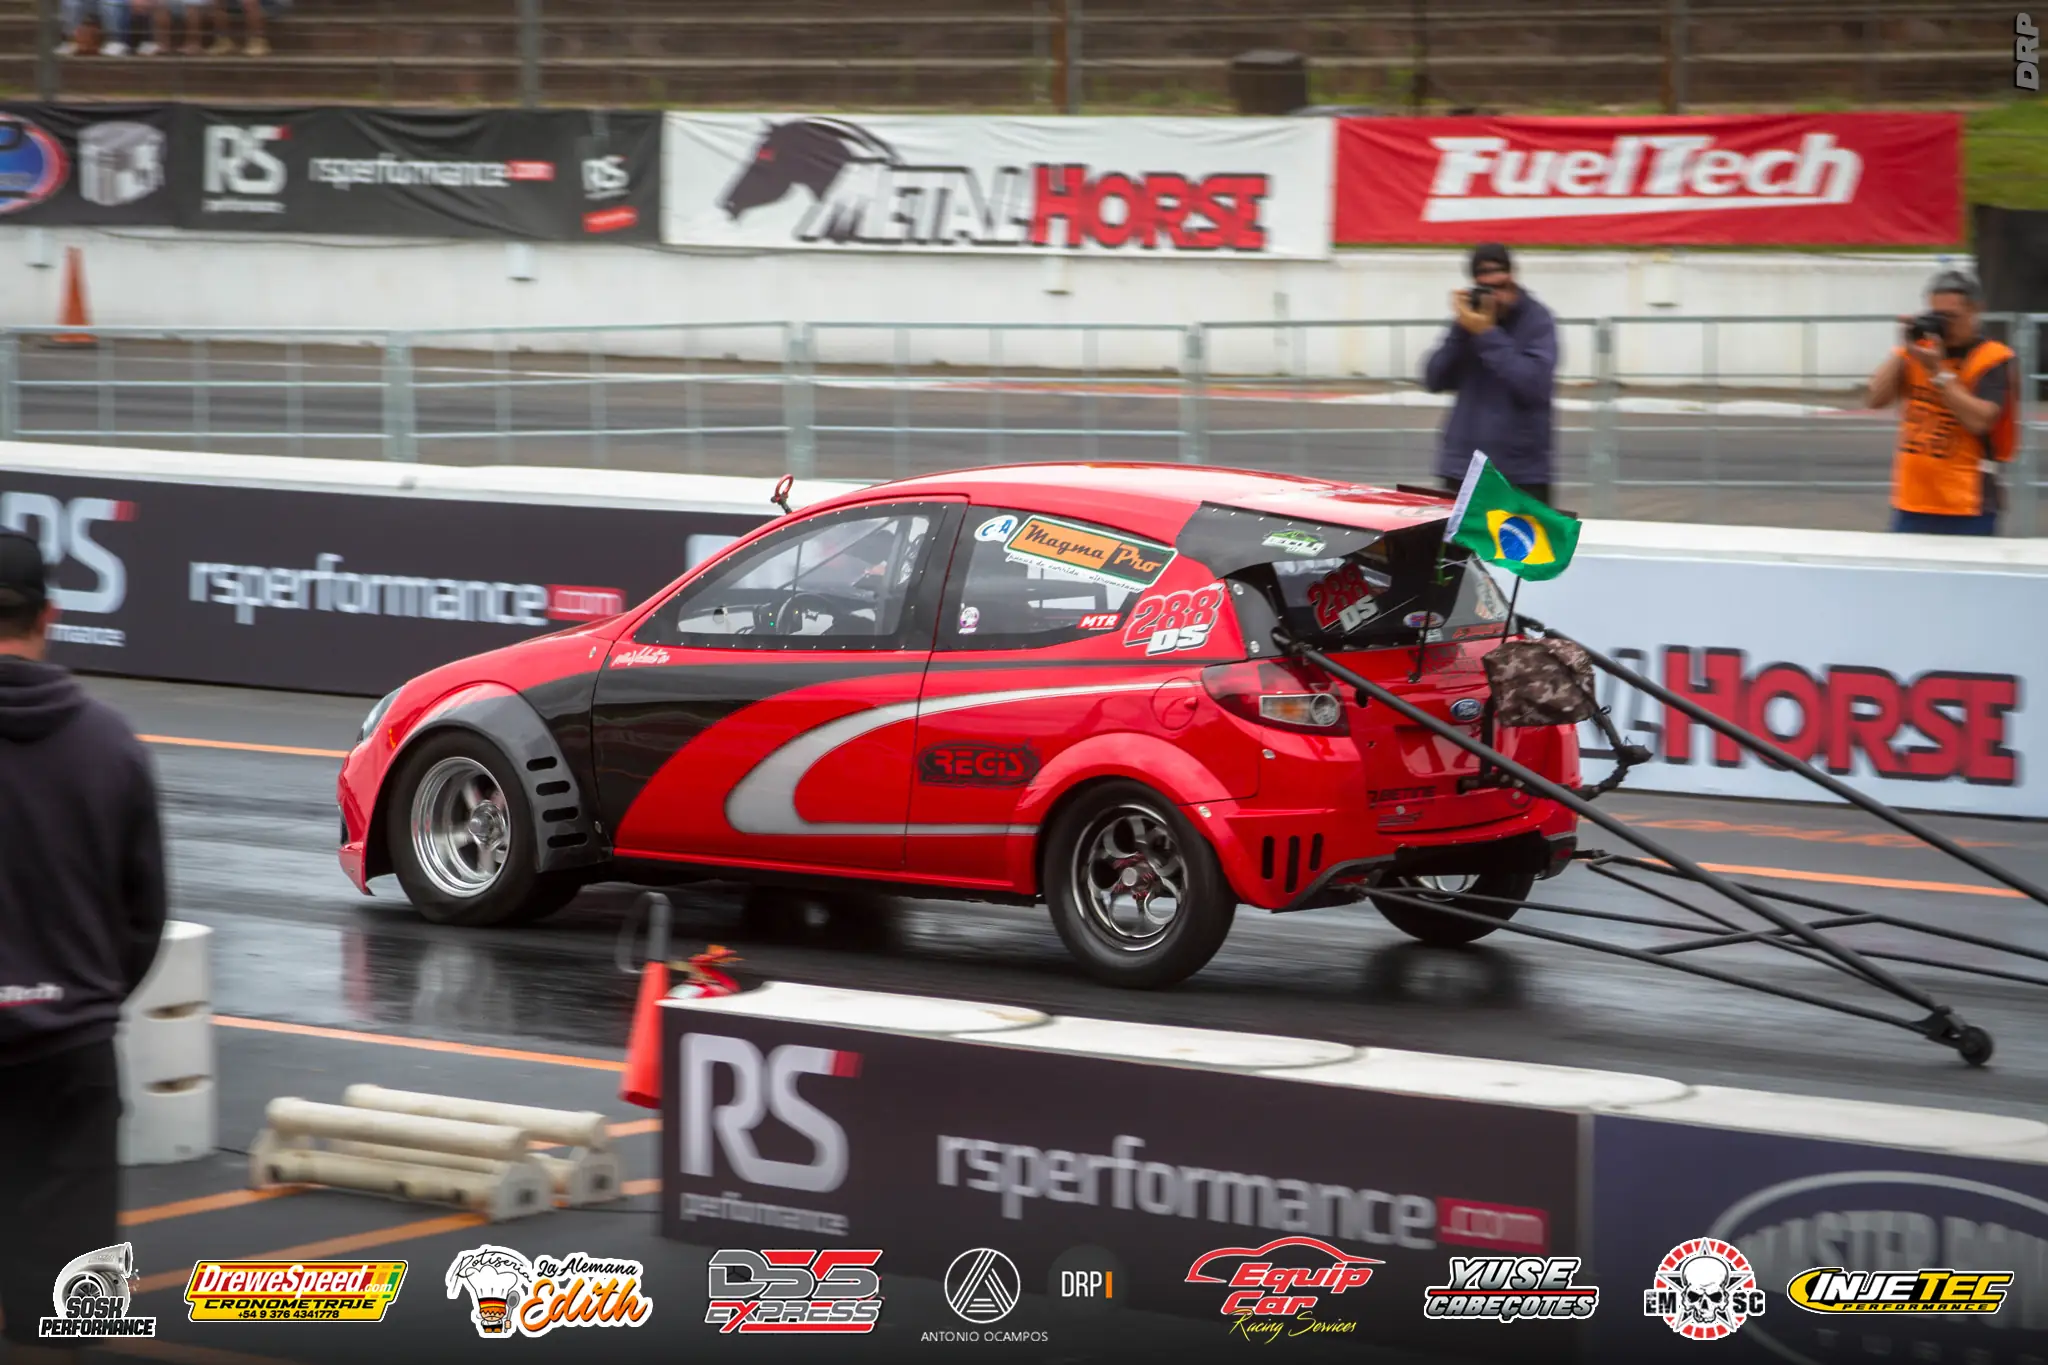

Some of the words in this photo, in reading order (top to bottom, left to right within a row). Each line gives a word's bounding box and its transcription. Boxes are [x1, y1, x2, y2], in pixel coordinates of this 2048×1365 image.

[204, 125, 292, 193] RS
[1430, 133, 1864, 203] FuelTech
[1025, 525, 1104, 556] Magma
[1113, 545, 1162, 573] Pro
[1081, 615, 1118, 627] MTR
[1125, 584, 1225, 647] 288
[1307, 563, 1369, 632] 288
[1339, 595, 1380, 634] DS
[1146, 624, 1209, 656] DS
[681, 1033, 863, 1193] RS
